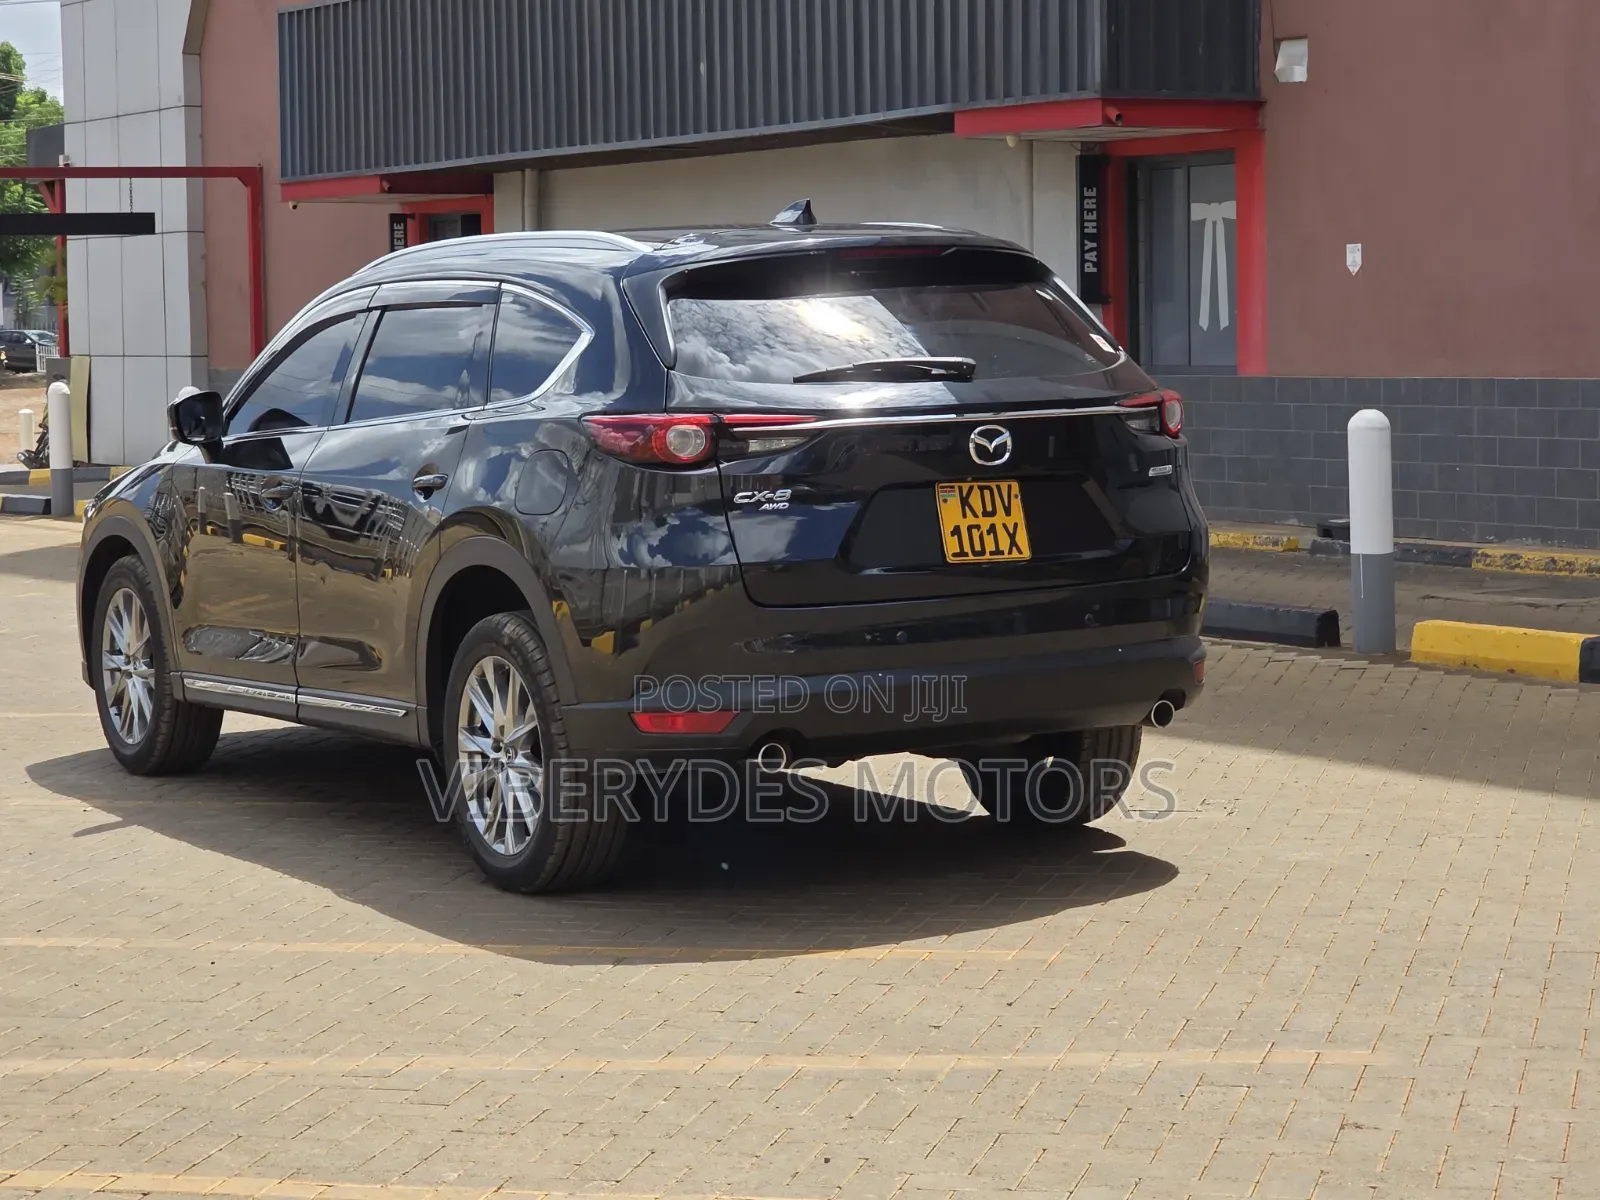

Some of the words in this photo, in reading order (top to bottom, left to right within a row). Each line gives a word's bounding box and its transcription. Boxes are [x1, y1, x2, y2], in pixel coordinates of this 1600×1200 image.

[1083, 186, 1098, 234] HERE
[1084, 240, 1098, 273] PAY
[733, 489, 792, 503] CX-8
[758, 502, 790, 511] AWD
[957, 483, 1012, 519] KDV
[950, 522, 1024, 558] 101X
